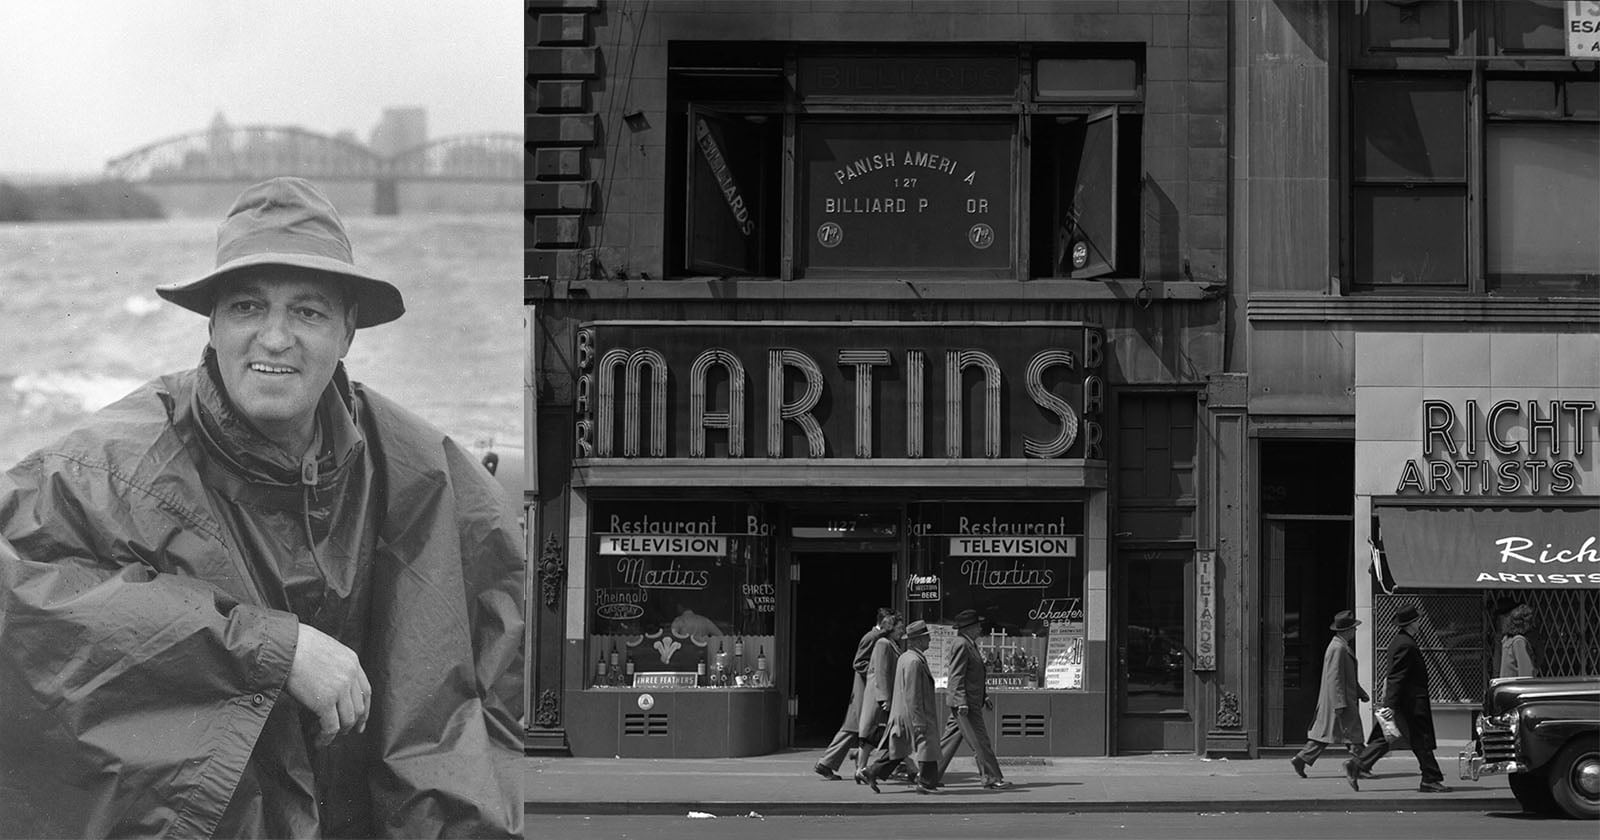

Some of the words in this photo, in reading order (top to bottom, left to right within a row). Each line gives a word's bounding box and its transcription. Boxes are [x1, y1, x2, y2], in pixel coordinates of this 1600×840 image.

[816, 64, 1002, 90] BILLIARDS
[698, 132, 756, 237] BILLIARDS
[825, 199, 906, 213] BILLIARD
[576, 329, 592, 457] BAR
[599, 348, 1077, 458] MARTINS
[1084, 327, 1104, 459] BAR
[1423, 400, 1595, 455] RICHT
[1397, 460, 1576, 493] ARTISTS
[610, 514, 717, 535] Restaurant
[959, 516, 1065, 535] Restaurant
[610, 538, 719, 553] TELEVISION
[960, 539, 1068, 554] TELEVISION
[617, 557, 709, 590] Martins
[960, 559, 1055, 589] Martins
[1476, 572, 1600, 584] ARTISTS
[594, 588, 648, 606] Rheingold
[1028, 599, 1084, 620] Schaefer
[1200, 552, 1213, 654] BILLIARDS
[637, 676, 658, 684] THREE
[660, 676, 694, 685] FEATHERS
